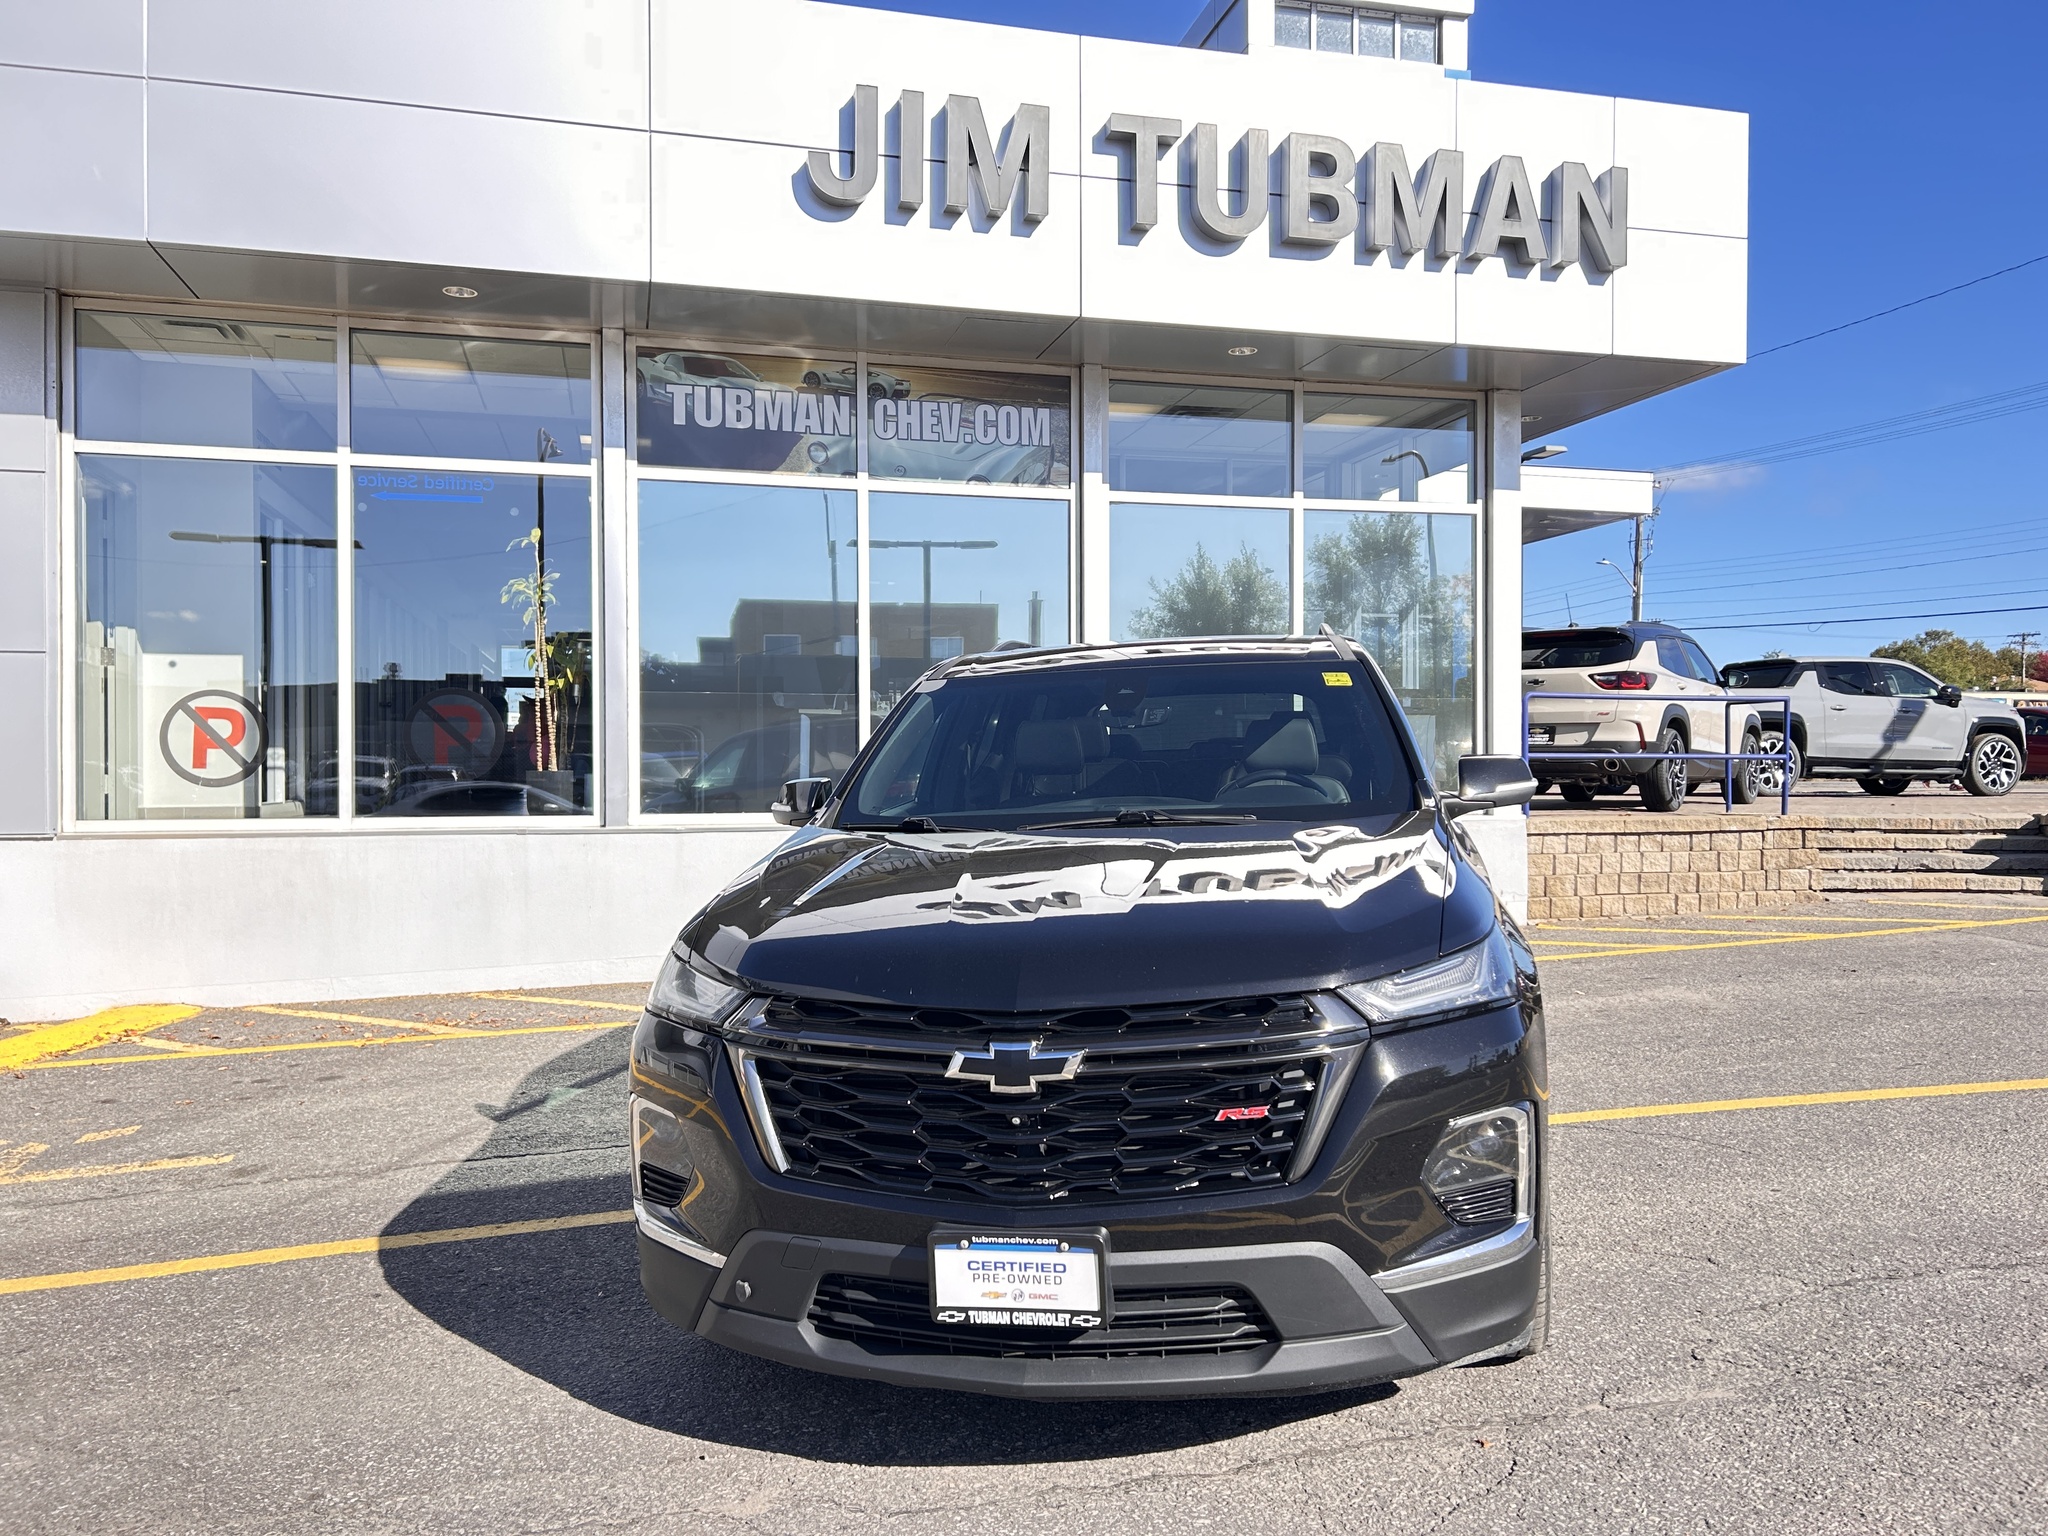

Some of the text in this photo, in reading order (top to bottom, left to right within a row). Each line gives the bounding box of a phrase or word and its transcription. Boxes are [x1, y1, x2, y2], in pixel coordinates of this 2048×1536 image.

[806, 84, 1629, 272] JIM TUBMAN
[665, 382, 1052, 448] TUBMAN CHEV.COM
[191, 706, 247, 770] P
[1214, 1104, 1271, 1121] RS
[971, 1235, 1059, 1245] tubmanchev.com
[967, 1260, 1067, 1273] CERTIFIED
[972, 1273, 1063, 1286] PRE-OWNED
[1028, 1292, 1059, 1301] GMC
[967, 1310, 1072, 1327] TUBMAN CHEVROLET
